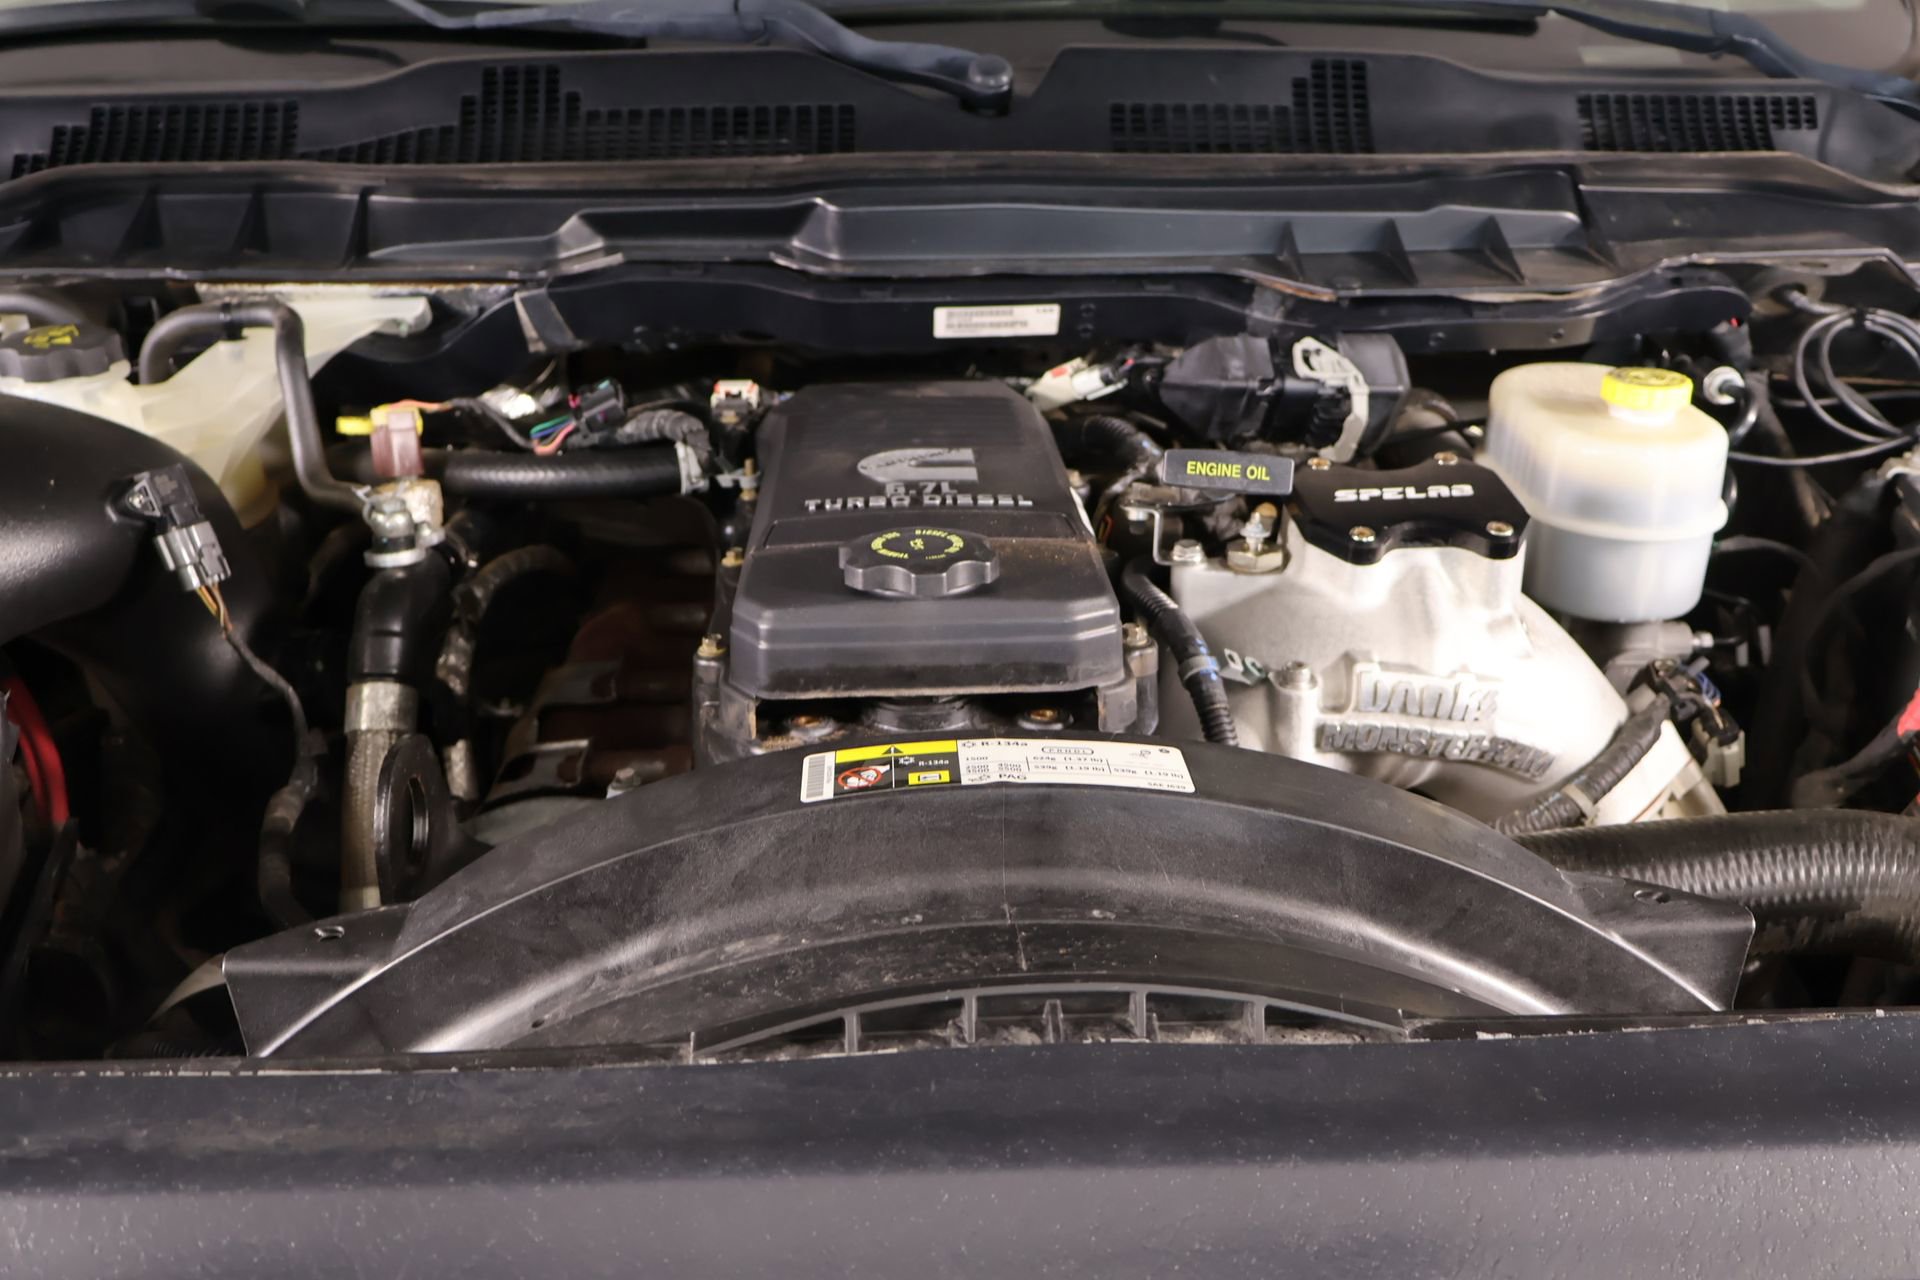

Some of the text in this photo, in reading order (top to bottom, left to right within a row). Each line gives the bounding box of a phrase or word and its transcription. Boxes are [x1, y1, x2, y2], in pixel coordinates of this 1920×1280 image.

[1186, 460, 1270, 481] ENGINE OIL
[885, 481, 958, 498] 6.7L
[1333, 483, 1475, 502] SPELAB
[804, 493, 1034, 512] TURBO DIESEL
[918, 759, 950, 767] R-134a
